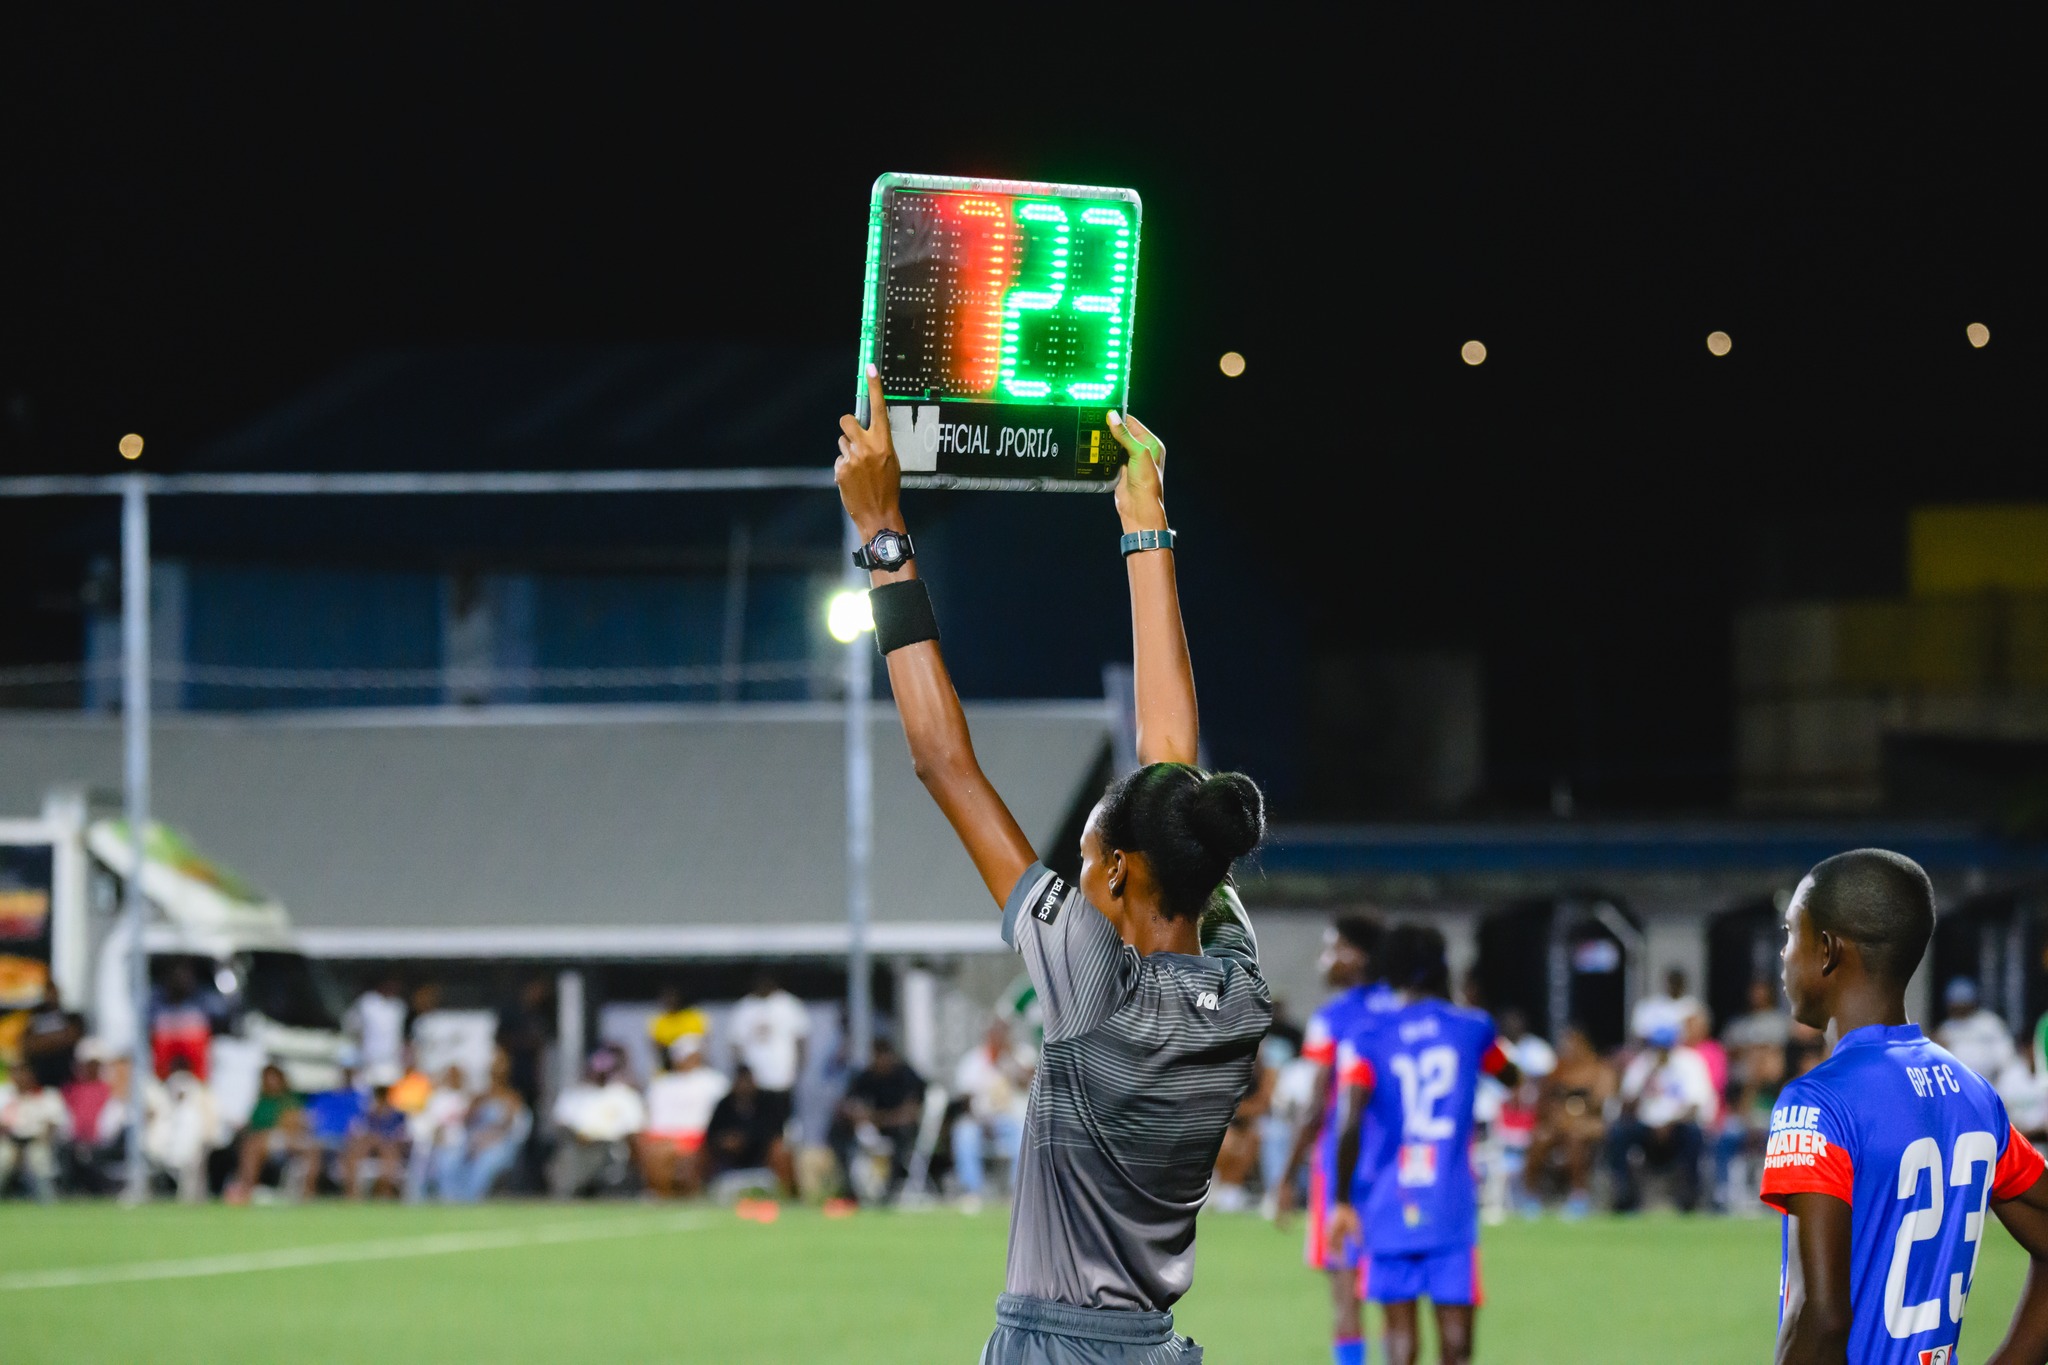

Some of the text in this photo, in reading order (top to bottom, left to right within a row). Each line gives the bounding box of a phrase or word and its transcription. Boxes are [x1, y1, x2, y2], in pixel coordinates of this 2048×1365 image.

[923, 423, 990, 455] OFFICIAL
[1389, 1045, 1460, 1141] 12
[1906, 1063, 1960, 1098] GPF FC
[1771, 1105, 1821, 1131] BLUE
[1764, 1154, 1816, 1169] SHIPPING
[1884, 1131, 1998, 1340] 23
